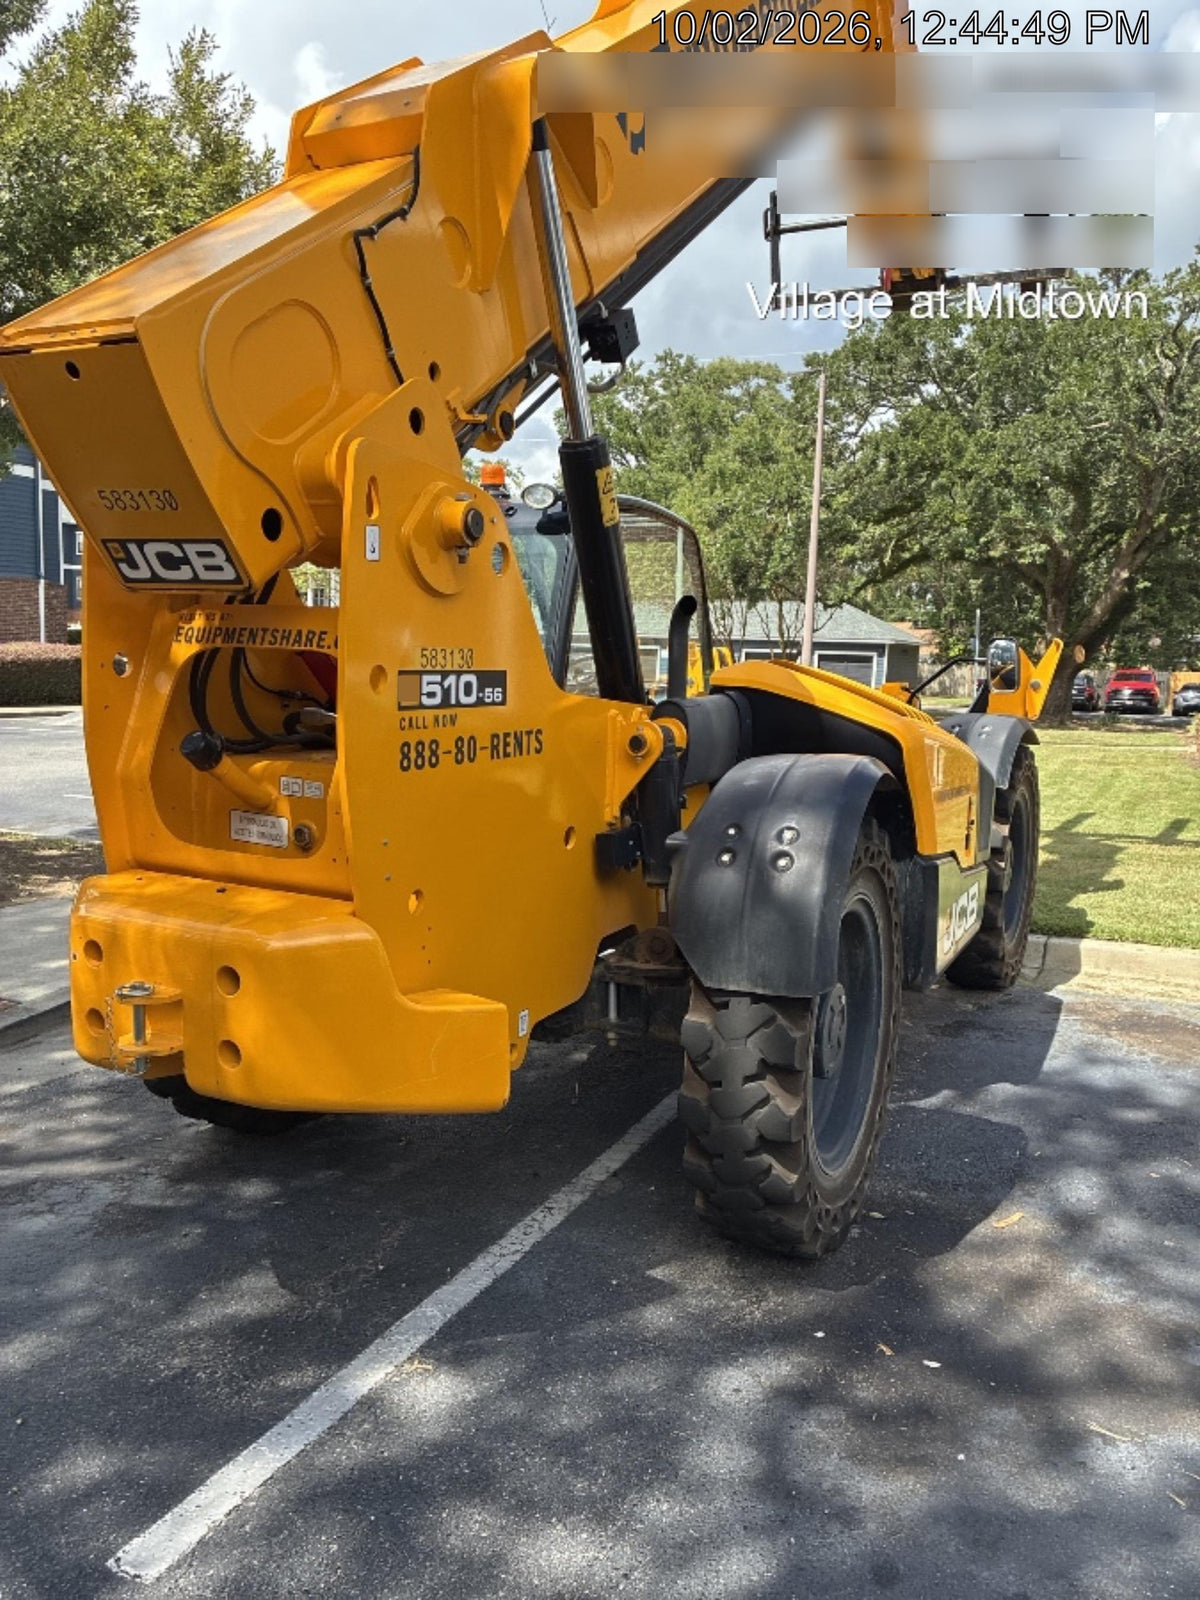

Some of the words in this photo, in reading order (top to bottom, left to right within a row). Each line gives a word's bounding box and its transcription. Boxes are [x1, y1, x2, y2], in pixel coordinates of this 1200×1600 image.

[97, 489, 179, 512] 583130
[117, 542, 238, 581] JCB
[420, 648, 474, 669] 583130
[399, 715, 429, 731] CALL
[433, 712, 458, 727] NOW
[399, 729, 543, 773] 888-80-RENTS
